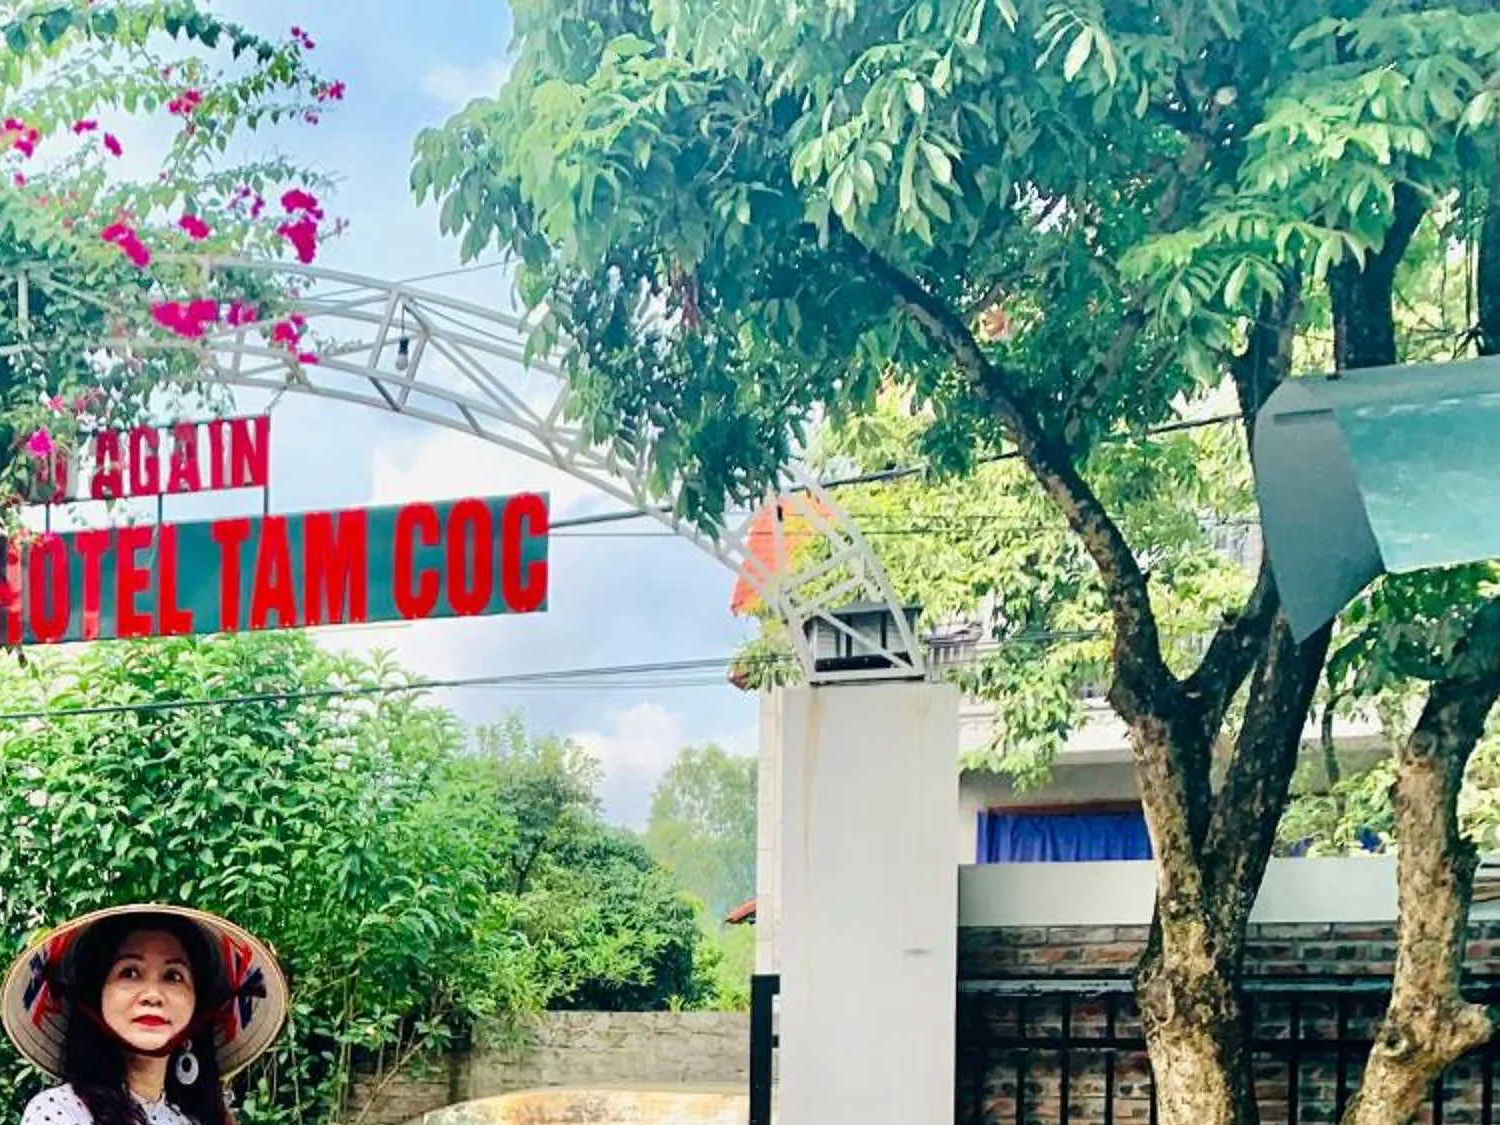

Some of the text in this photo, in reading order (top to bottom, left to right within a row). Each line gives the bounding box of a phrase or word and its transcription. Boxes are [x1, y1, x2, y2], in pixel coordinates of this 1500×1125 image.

[91, 416, 271, 500] AGAIN
[211, 509, 370, 632] TAM
[392, 491, 551, 621] COC
